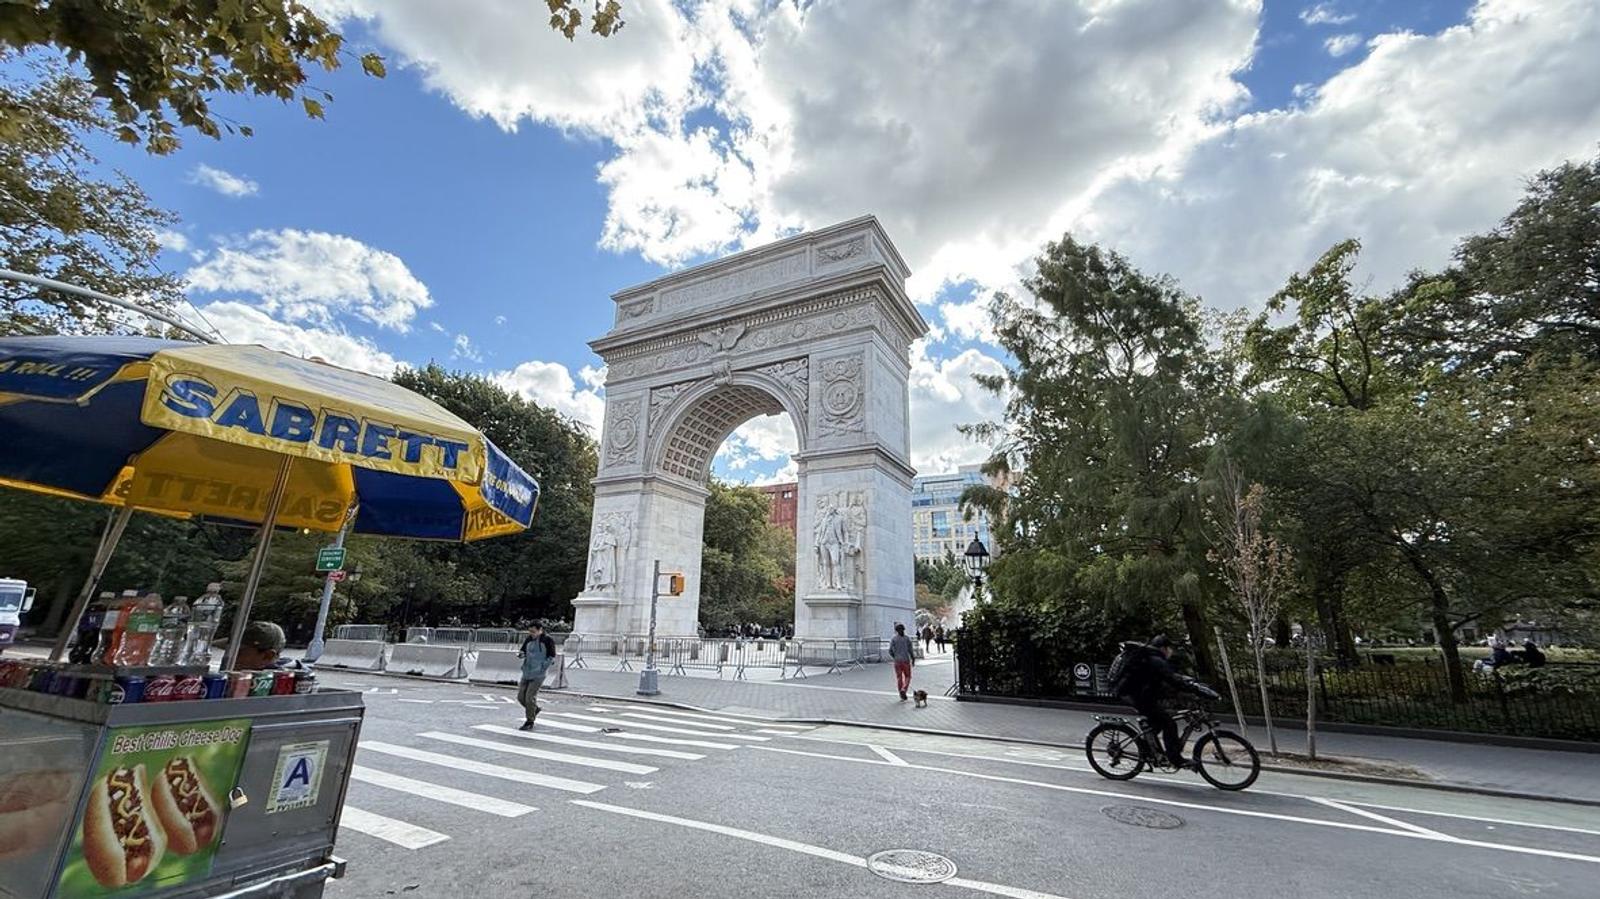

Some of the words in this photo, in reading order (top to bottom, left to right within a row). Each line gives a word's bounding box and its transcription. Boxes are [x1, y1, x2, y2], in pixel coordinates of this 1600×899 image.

[63, 367, 99, 381] !!!
[161, 373, 469, 470] SABRETT
[112, 735, 144, 754] Best
[180, 729, 220, 746] Cheese
[219, 726, 243, 745] Dog
[283, 758, 309, 788] A
